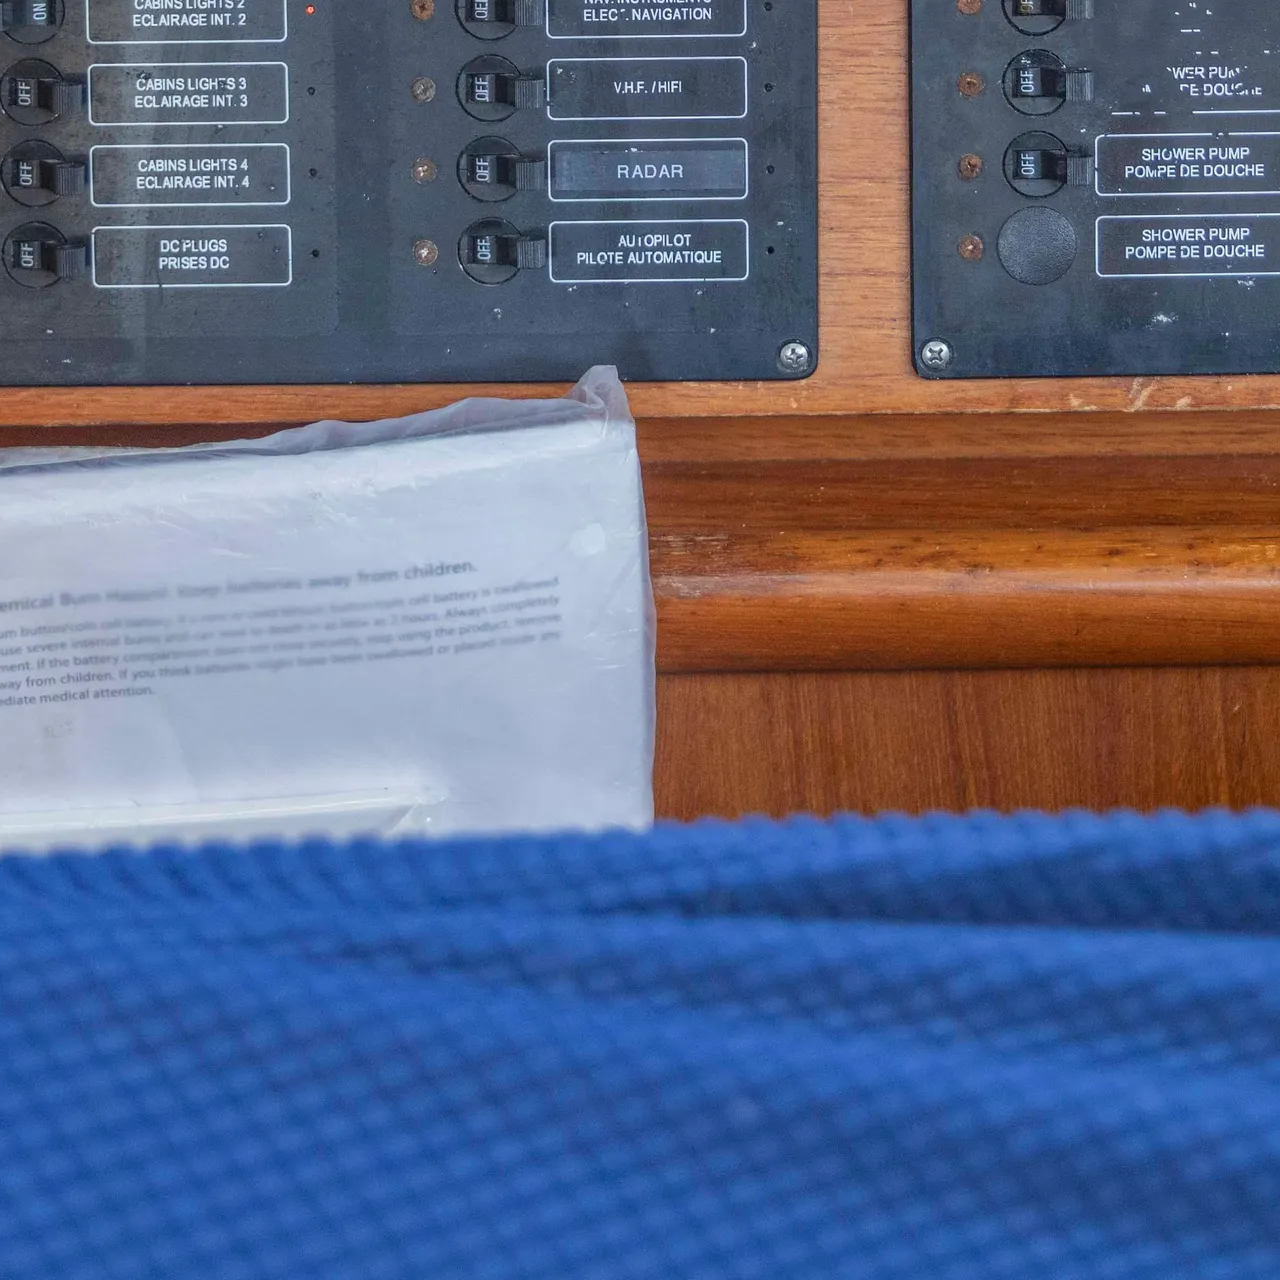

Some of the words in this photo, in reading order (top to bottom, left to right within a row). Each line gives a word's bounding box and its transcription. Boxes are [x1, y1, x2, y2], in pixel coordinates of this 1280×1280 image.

[618, 165, 683, 178] RADAR
[1143, 229, 1205, 241] SHOWER
[1210, 228, 1249, 240] PUMP
[161, 240, 179, 252] DC
[182, 239, 227, 252] PLUGS
[1126, 246, 1176, 258] POMPE
[1181, 246, 1199, 258] DE
[1204, 245, 1264, 257] DOUCHE
[160, 257, 207, 269] PRISES
[210, 256, 229, 268] DC
[577, 252, 623, 264] PILOTE
[628, 251, 721, 264] AUTOMATIQUE
